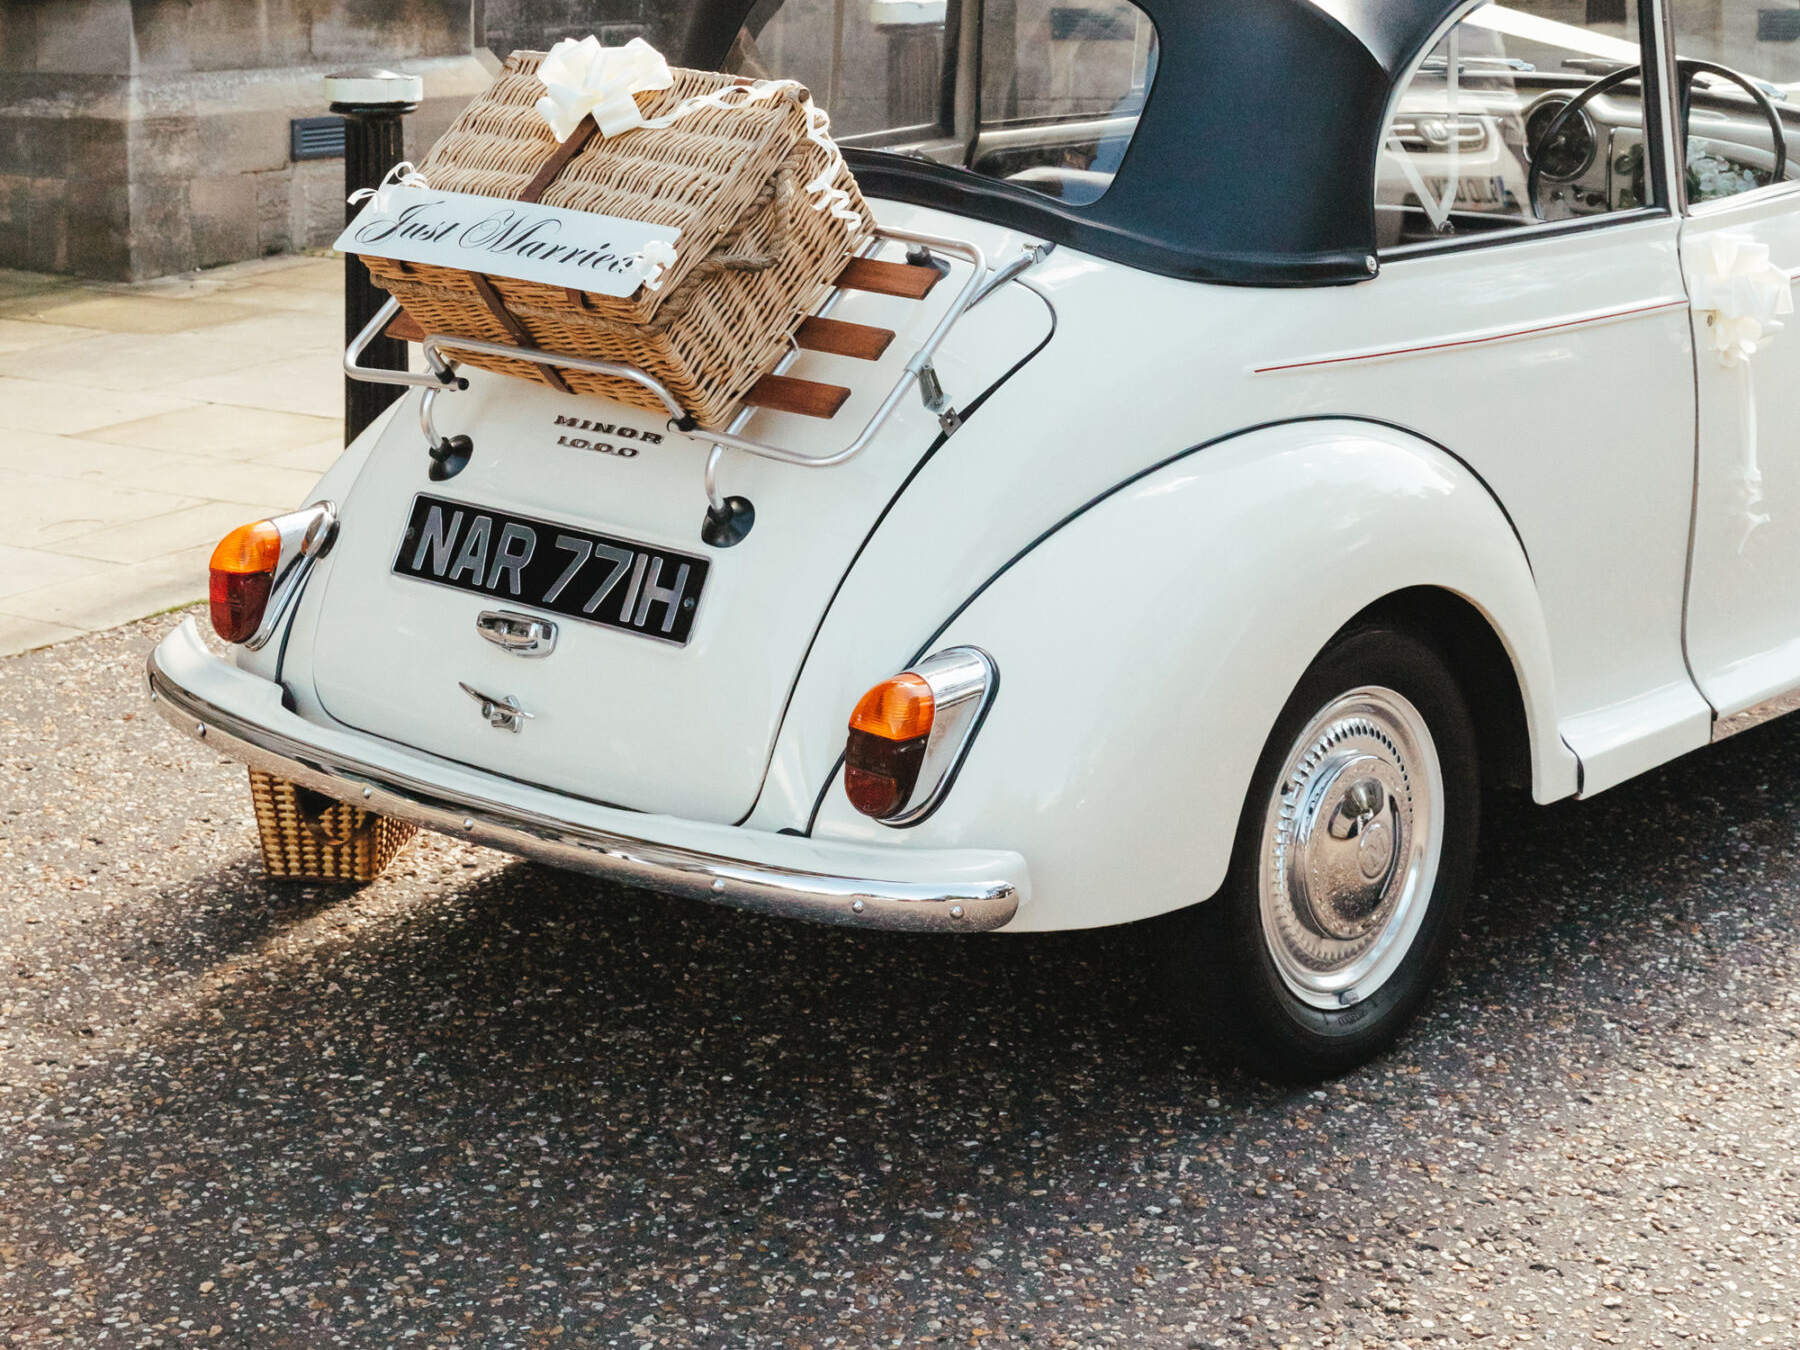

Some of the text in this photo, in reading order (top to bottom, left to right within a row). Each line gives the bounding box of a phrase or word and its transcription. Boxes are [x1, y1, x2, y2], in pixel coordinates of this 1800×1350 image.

[354, 201, 460, 247] Just
[554, 415, 664, 445] MINOR
[557, 436, 640, 458] 1000
[411, 505, 691, 633] NAR 771H
